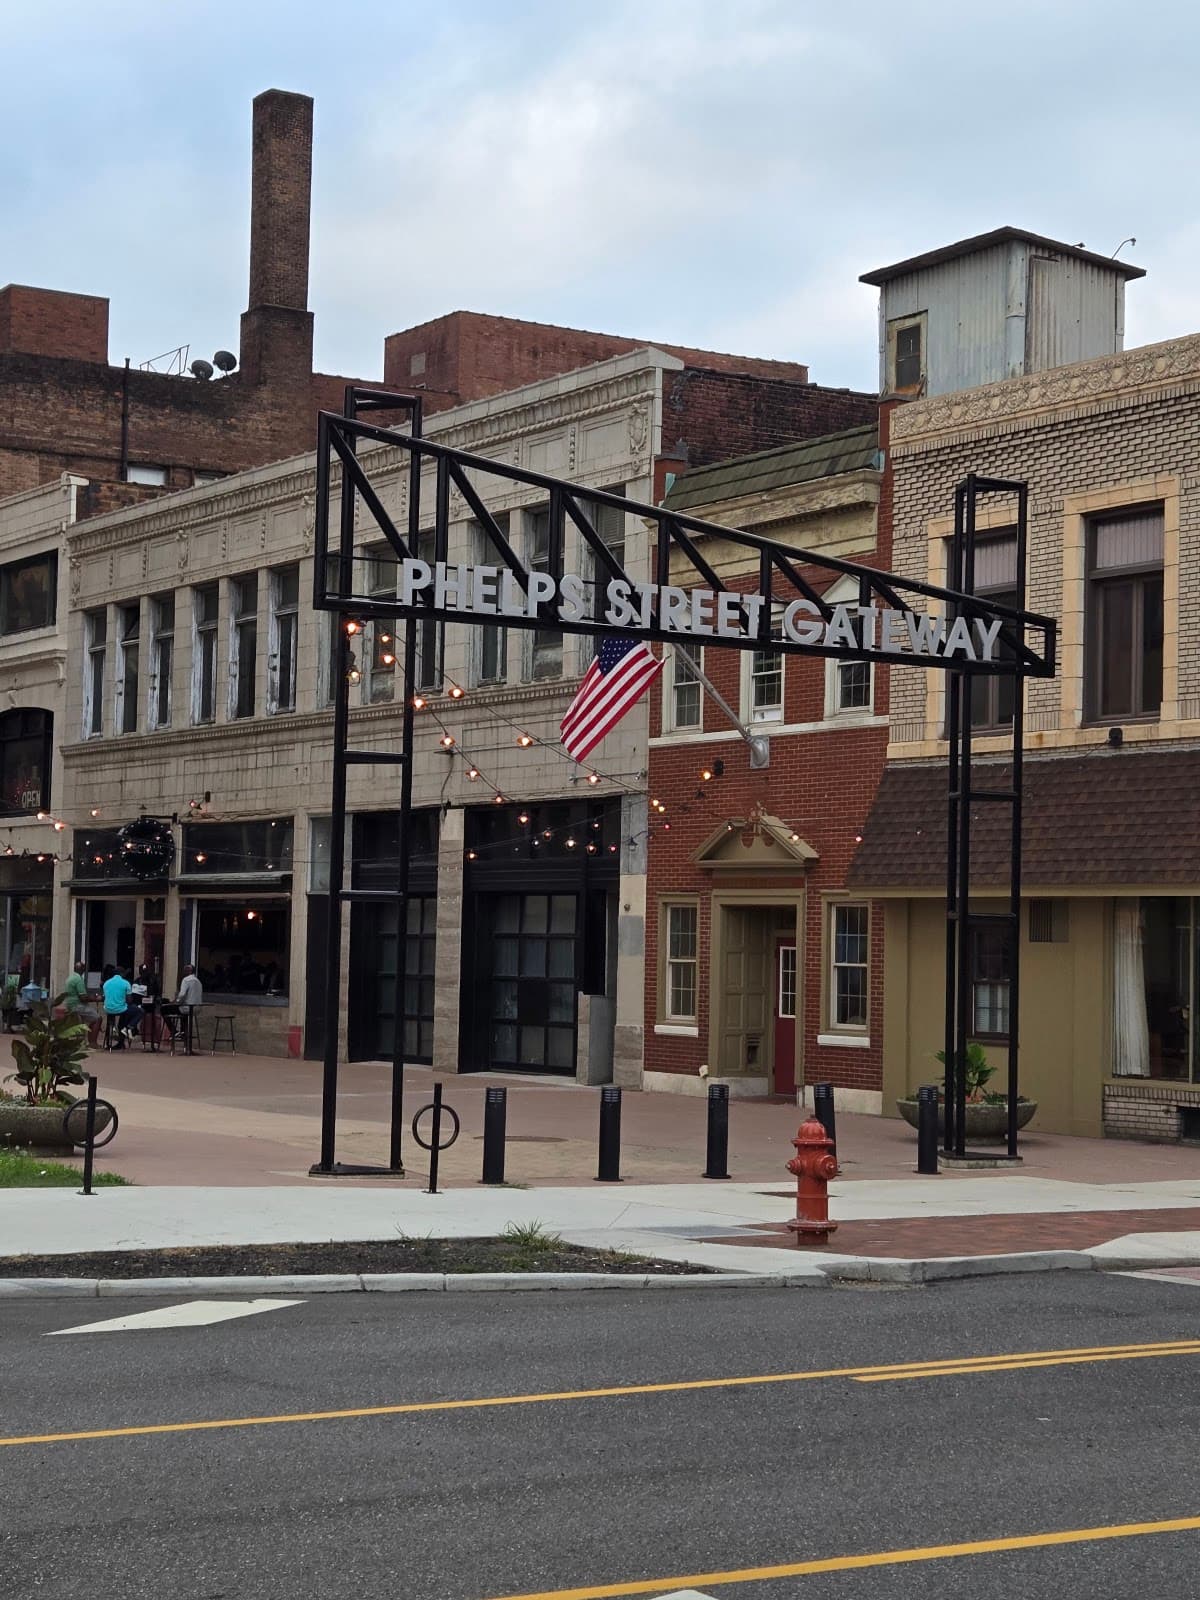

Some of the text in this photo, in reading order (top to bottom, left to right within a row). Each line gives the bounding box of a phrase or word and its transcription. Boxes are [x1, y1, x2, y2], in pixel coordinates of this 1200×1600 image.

[402, 558, 1003, 661] PHELPS STREET GATEWAY
[22, 790, 41, 809] OPEN
